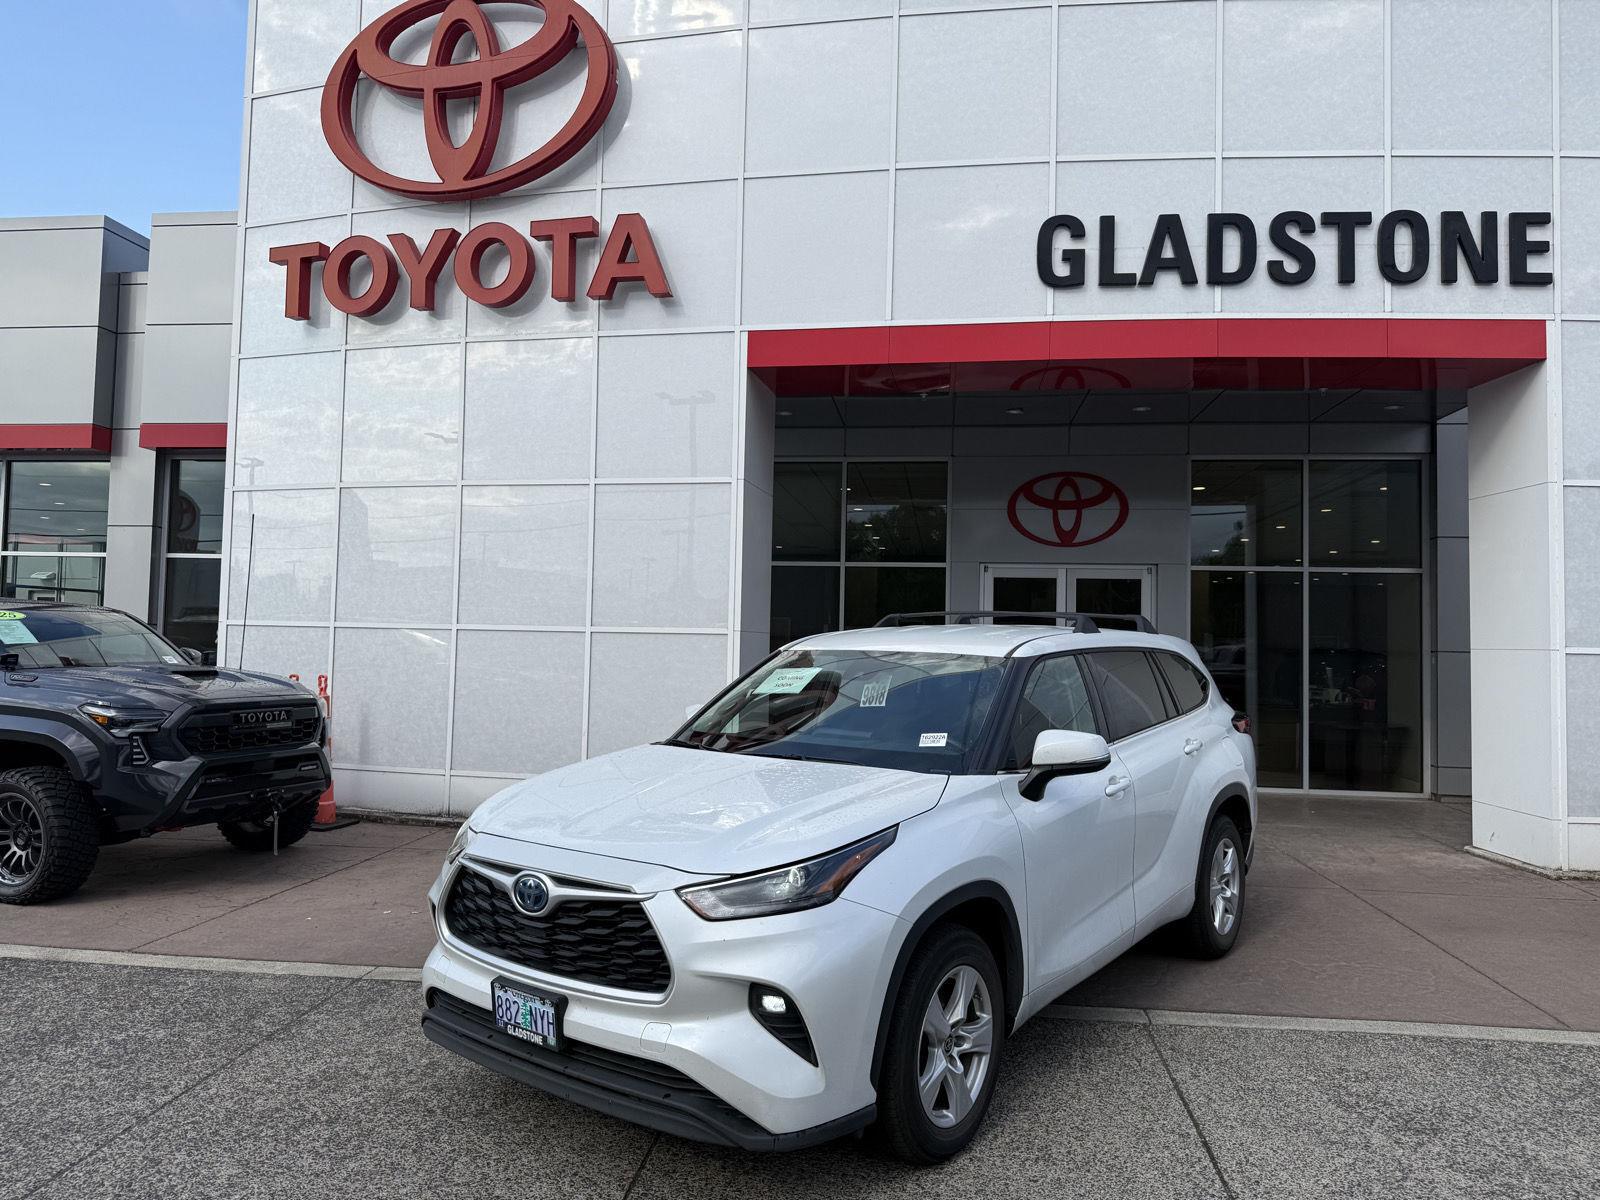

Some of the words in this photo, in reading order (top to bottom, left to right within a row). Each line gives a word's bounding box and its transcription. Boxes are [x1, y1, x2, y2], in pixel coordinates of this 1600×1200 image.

[269, 212, 674, 322] TOYOTA
[1036, 209, 1555, 288] GLADSTONE
[239, 711, 288, 723] TOYOTA
[496, 995, 521, 1026] 882
[529, 1005, 556, 1038] NYH
[507, 1024, 544, 1046] GLADSTONE
